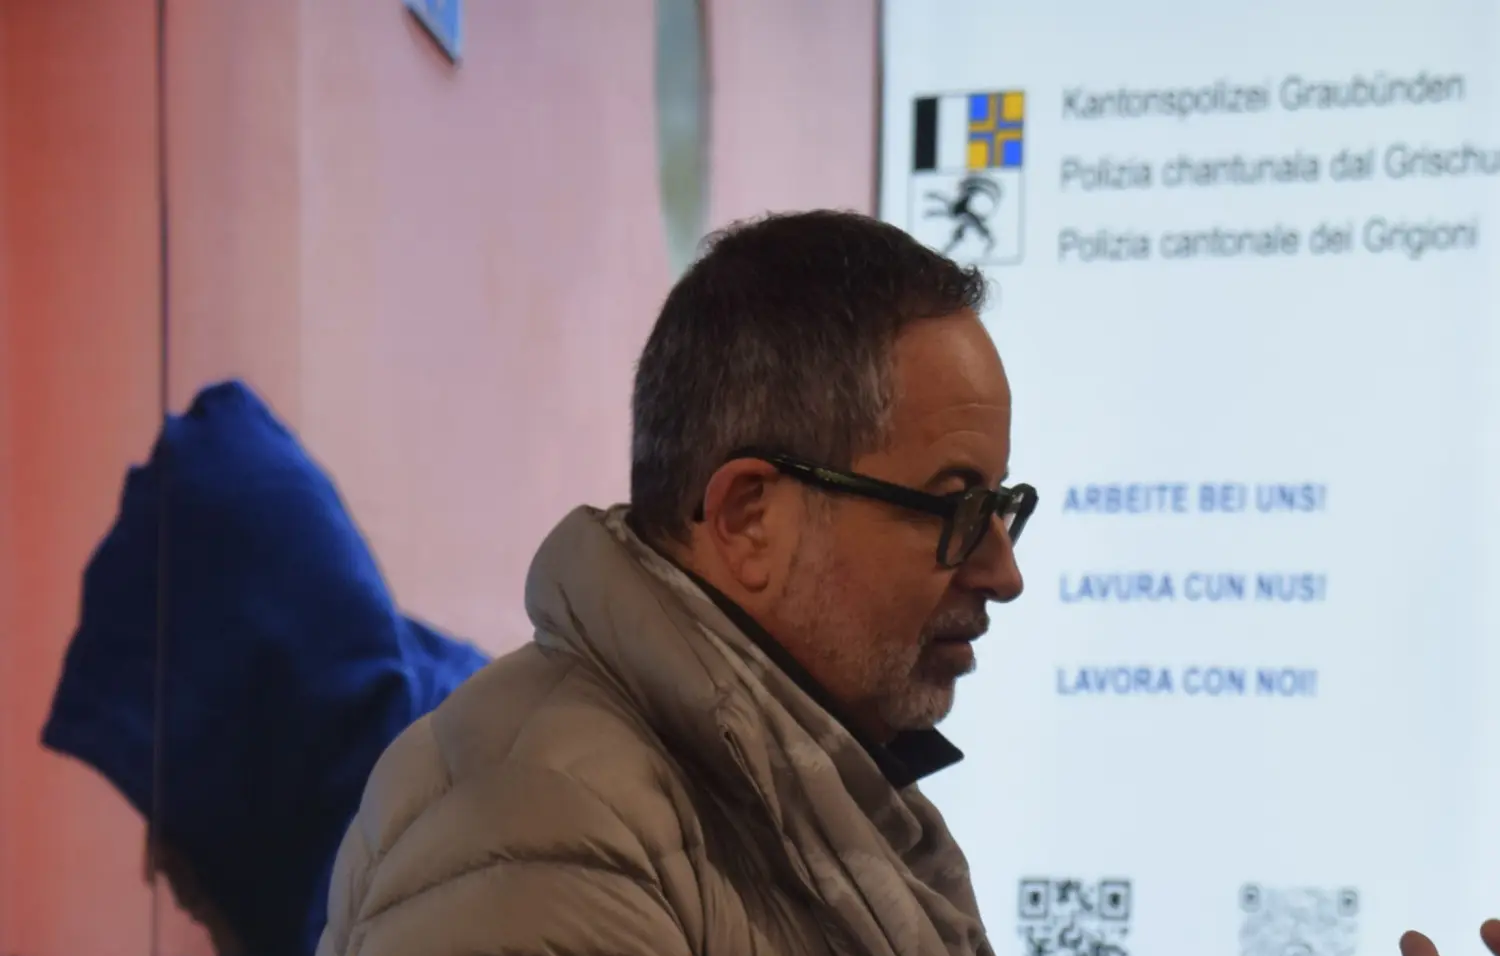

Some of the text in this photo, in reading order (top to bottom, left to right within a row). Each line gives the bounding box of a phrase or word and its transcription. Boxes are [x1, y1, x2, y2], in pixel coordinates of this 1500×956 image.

[1061, 70, 1465, 121] Kantonspolizei Graubünden
[1060, 154, 1151, 192] Polizia
[1160, 148, 1319, 187] chantunala
[1329, 148, 1374, 183] dal
[1057, 213, 1479, 263] Polizia cantonale dei Grigioni
[1063, 482, 1327, 514] ARBEITE BEI UNS!
[1059, 571, 1327, 604] LAVURA CUN NUS!
[1056, 665, 1319, 697] LAVORA CON NOI!
